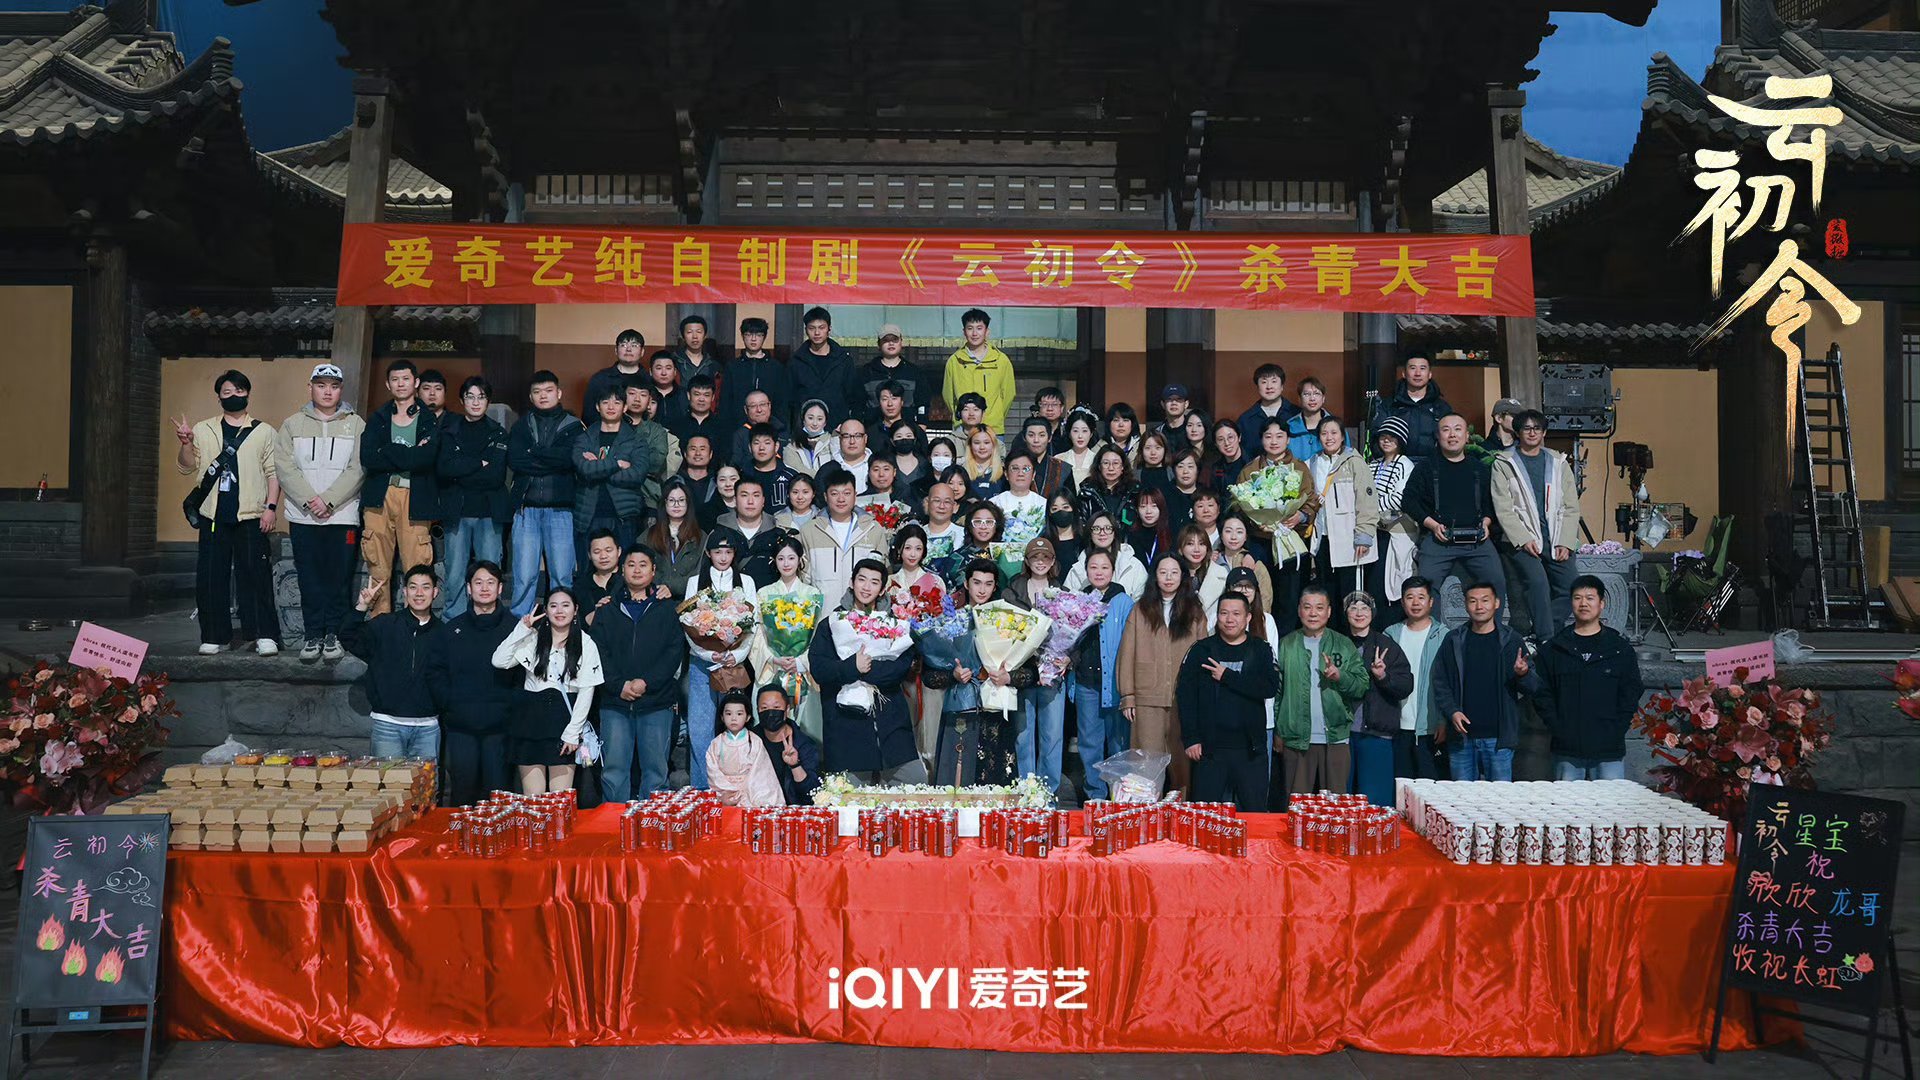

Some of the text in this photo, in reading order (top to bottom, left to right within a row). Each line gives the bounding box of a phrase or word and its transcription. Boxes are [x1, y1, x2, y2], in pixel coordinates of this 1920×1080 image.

[383, 236, 1499, 300] 爱奇艺纯自制剧《云初令》杀青大吉
[1332, 652, 1343, 668] B
[1754, 801, 1790, 874] 云初令
[1794, 813, 1849, 853] 星宝
[1805, 850, 1835, 880] 祝
[32, 866, 152, 960] 杀青大吉
[1829, 888, 1881, 927] 龙哥
[1737, 910, 1833, 954] 杀青大吉
[1732, 943, 1842, 991] 收视长虹
